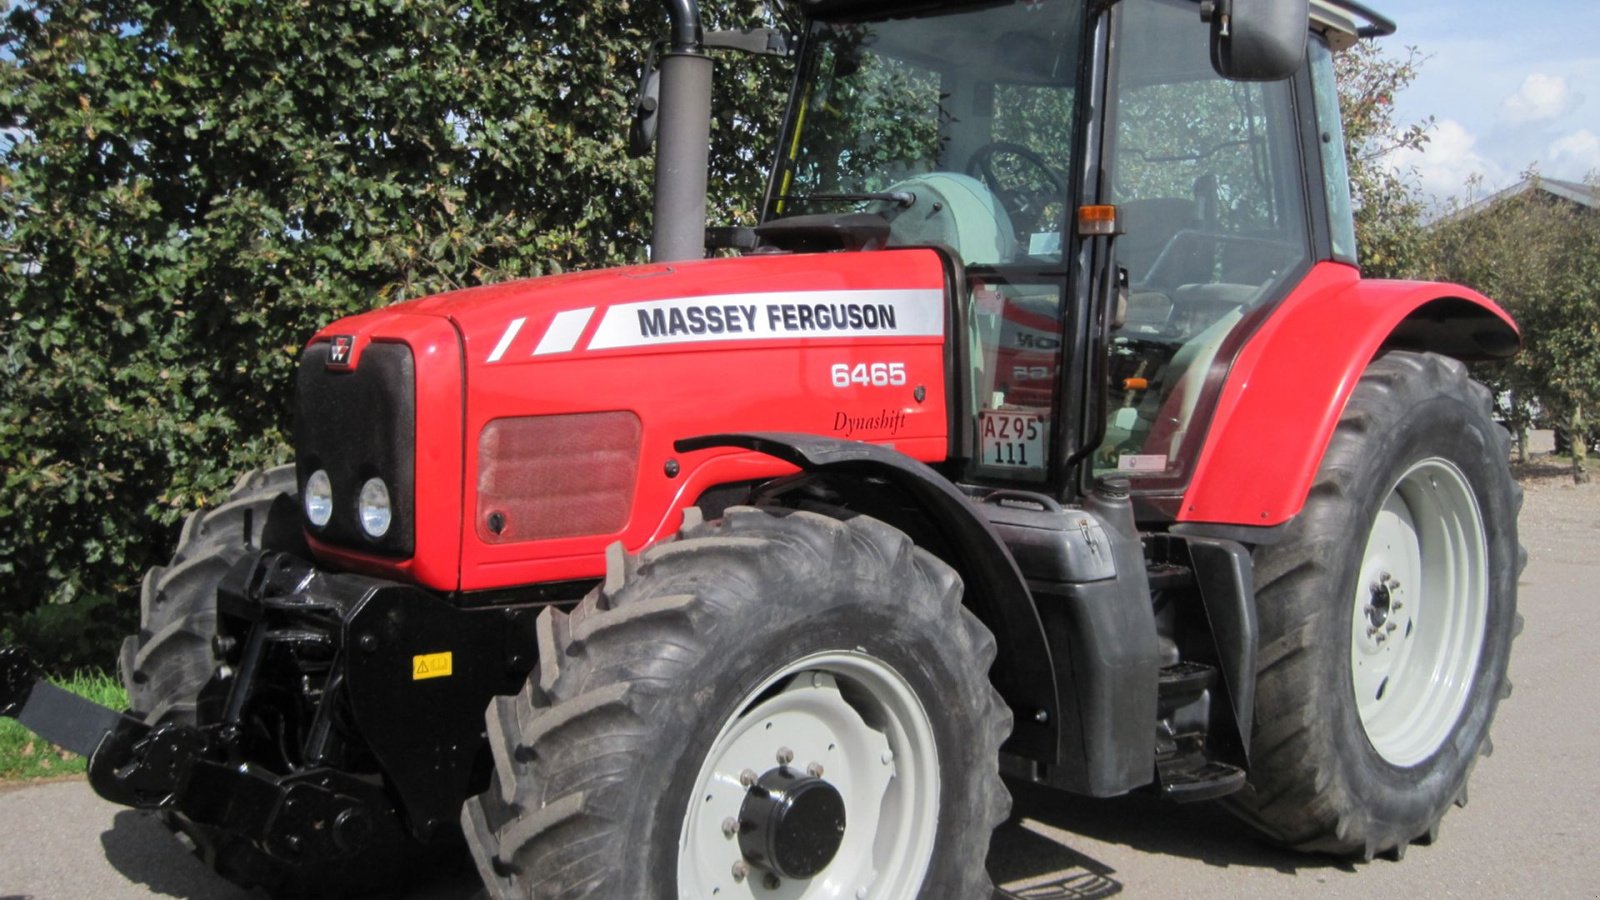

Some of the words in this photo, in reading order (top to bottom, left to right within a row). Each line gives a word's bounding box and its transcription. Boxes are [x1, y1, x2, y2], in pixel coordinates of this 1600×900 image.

[637, 304, 757, 338] MASSEY
[766, 303, 898, 332] FERGUSON
[831, 362, 907, 388] 6465
[833, 408, 907, 437] Dynashift
[994, 441, 1028, 465] 111
